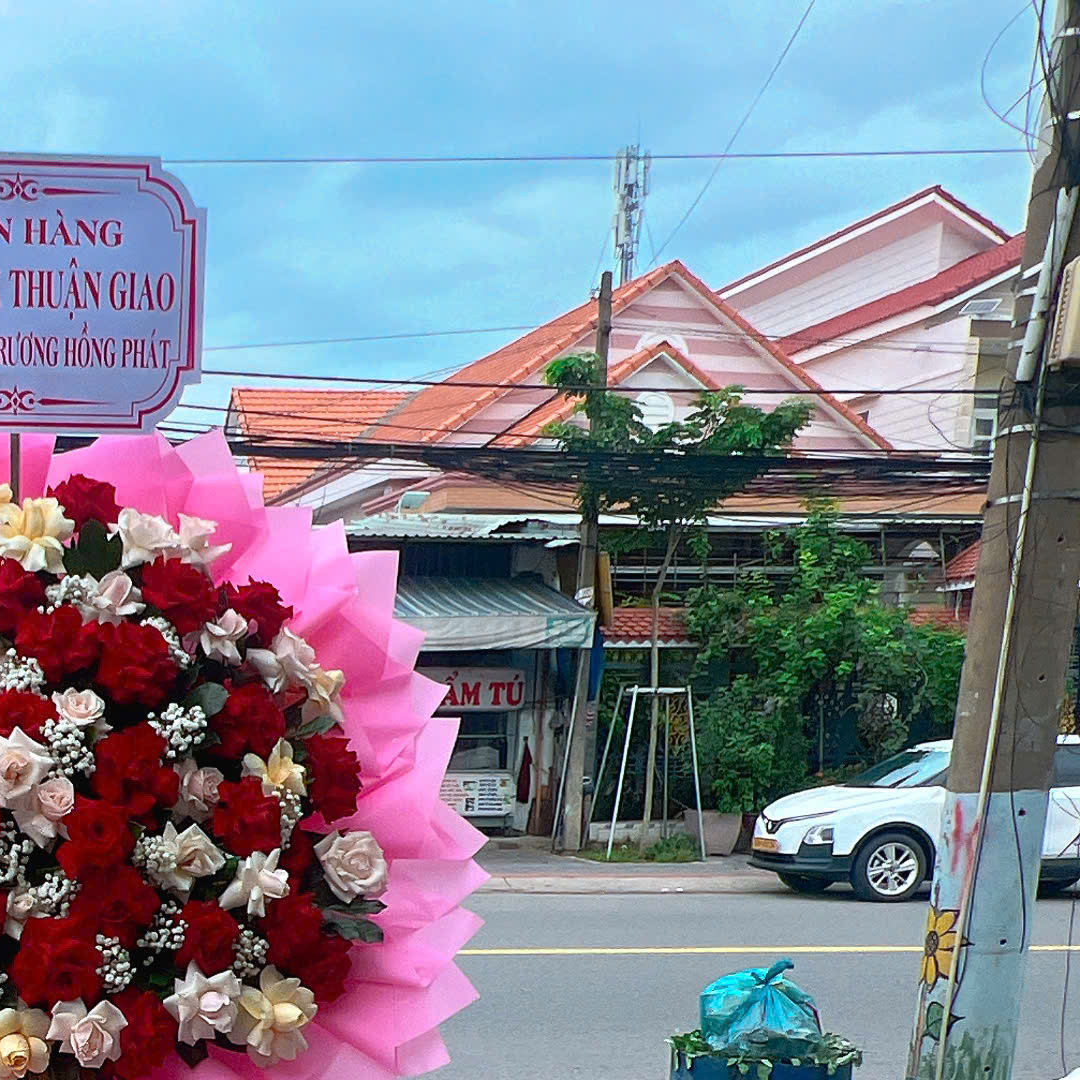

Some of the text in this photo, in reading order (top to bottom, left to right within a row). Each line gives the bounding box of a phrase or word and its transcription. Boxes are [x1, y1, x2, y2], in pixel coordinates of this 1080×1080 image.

[24, 208, 123, 247] HÀNG
[8, 257, 102, 321] THUẬN
[109, 271, 176, 311] GIAO
[63, 321, 116, 368] HỒNG
[121, 328, 171, 369] PHÁT
[488, 673, 525, 706] TÚ
